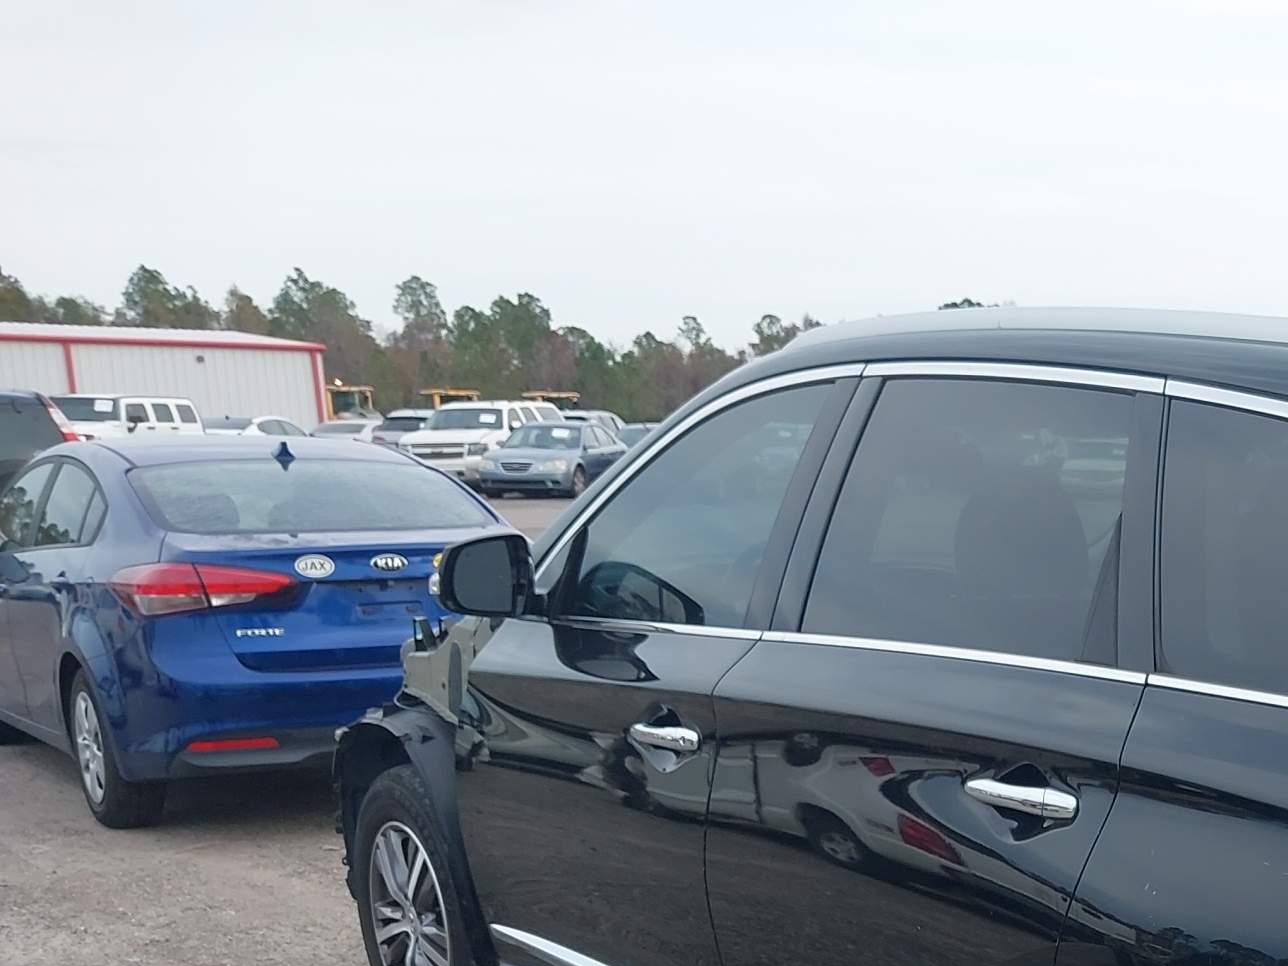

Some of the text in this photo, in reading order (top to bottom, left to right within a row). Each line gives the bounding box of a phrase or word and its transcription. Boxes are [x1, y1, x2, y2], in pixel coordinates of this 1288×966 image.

[300, 560, 330, 573] JAX
[375, 556, 405, 571] KIA
[236, 627, 285, 637] FORTE
